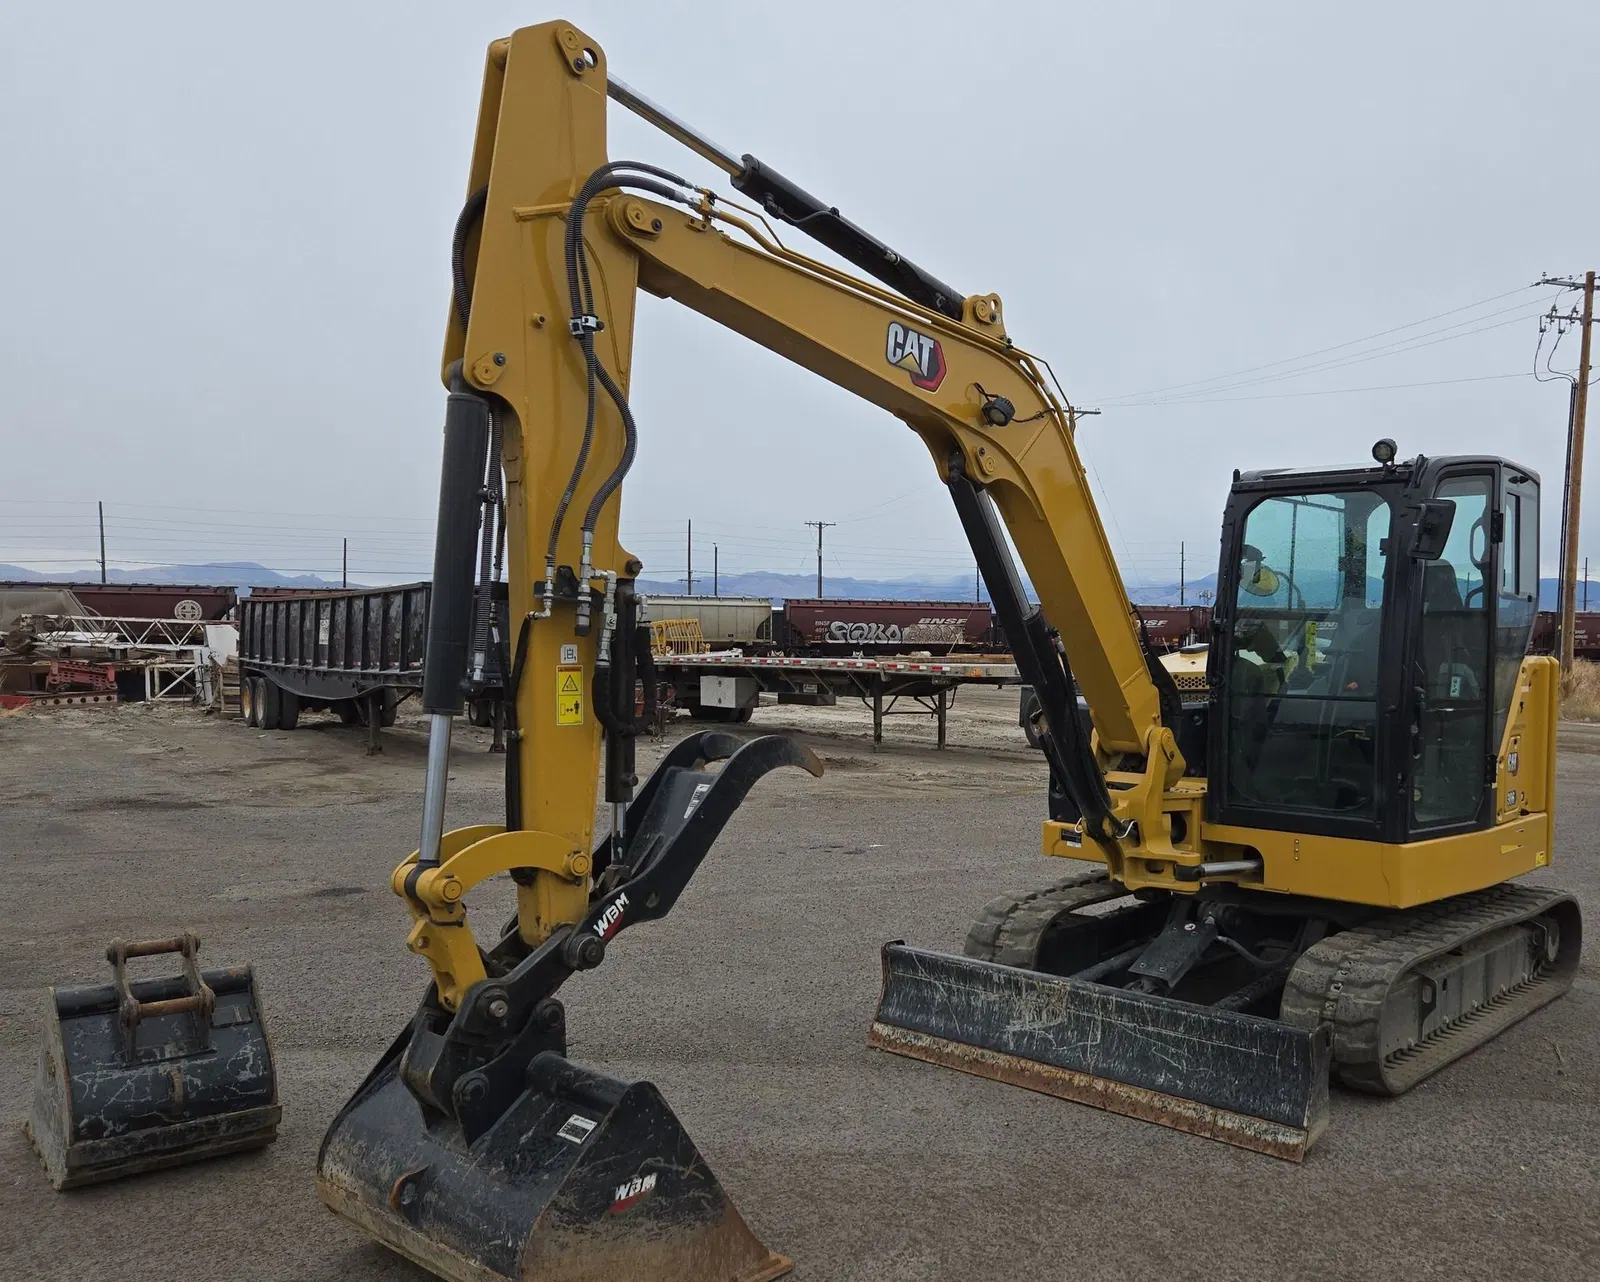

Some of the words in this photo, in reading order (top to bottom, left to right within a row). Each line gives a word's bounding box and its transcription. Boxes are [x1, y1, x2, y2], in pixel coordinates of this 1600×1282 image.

[887, 322, 934, 377] CAT
[1507, 753, 1518, 772] CAT
[593, 892, 630, 937] WBM
[615, 1172, 658, 1201] WBM
